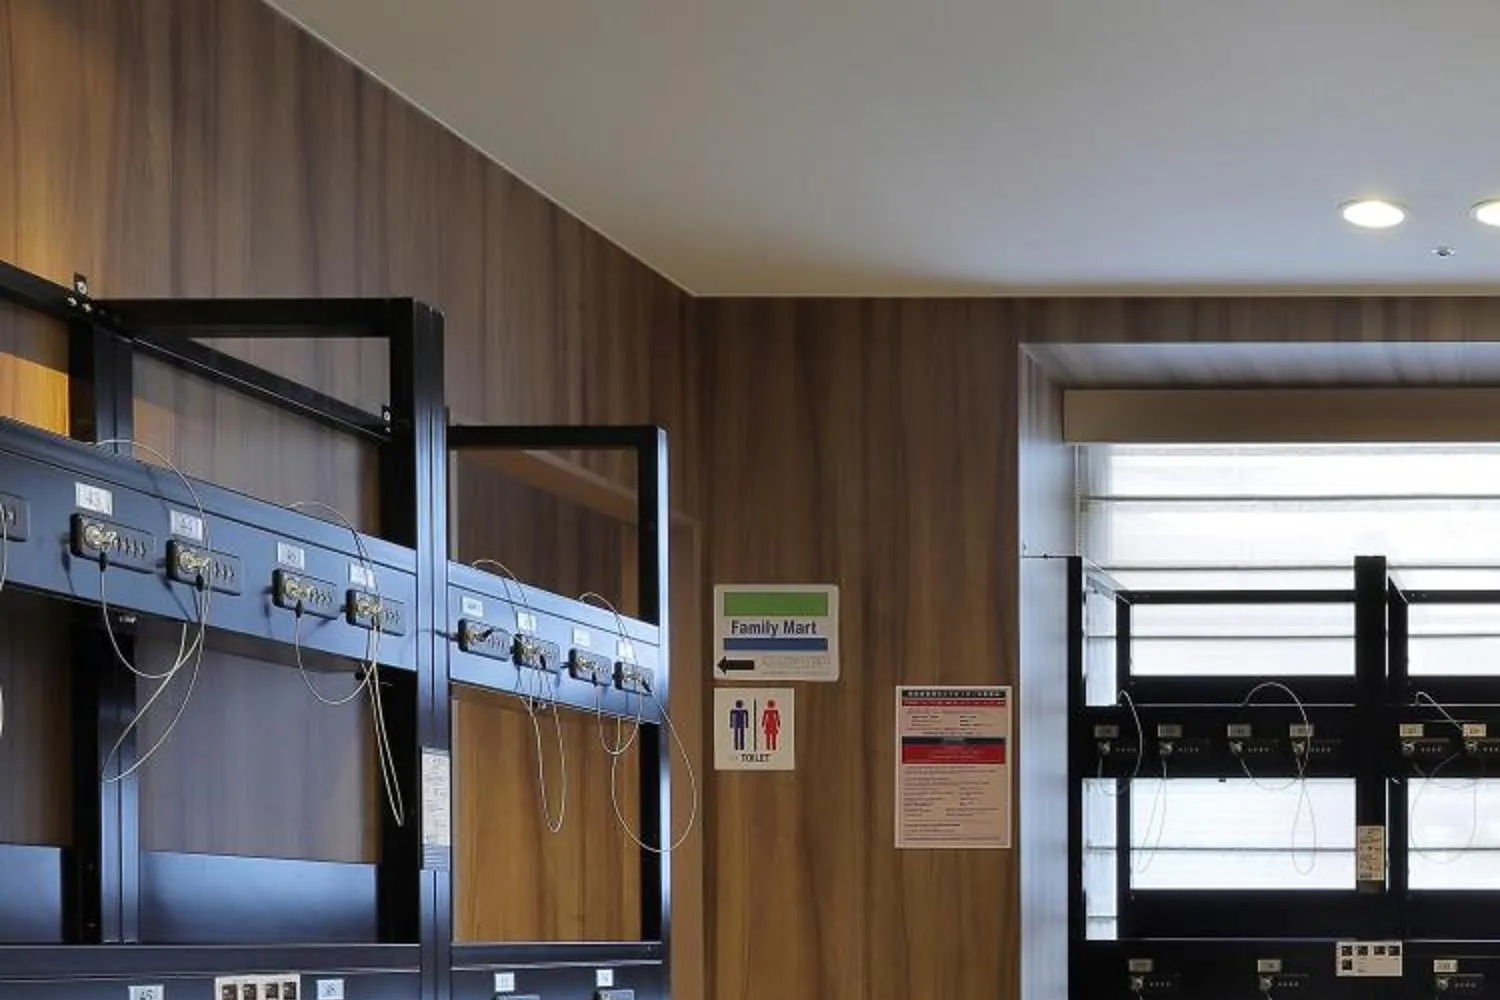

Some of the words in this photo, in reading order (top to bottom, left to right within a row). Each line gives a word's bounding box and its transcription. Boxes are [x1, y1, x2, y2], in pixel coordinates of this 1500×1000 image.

[731, 619, 778, 636] Family
[783, 620, 817, 635] Mart
[741, 753, 771, 763] TOILET
